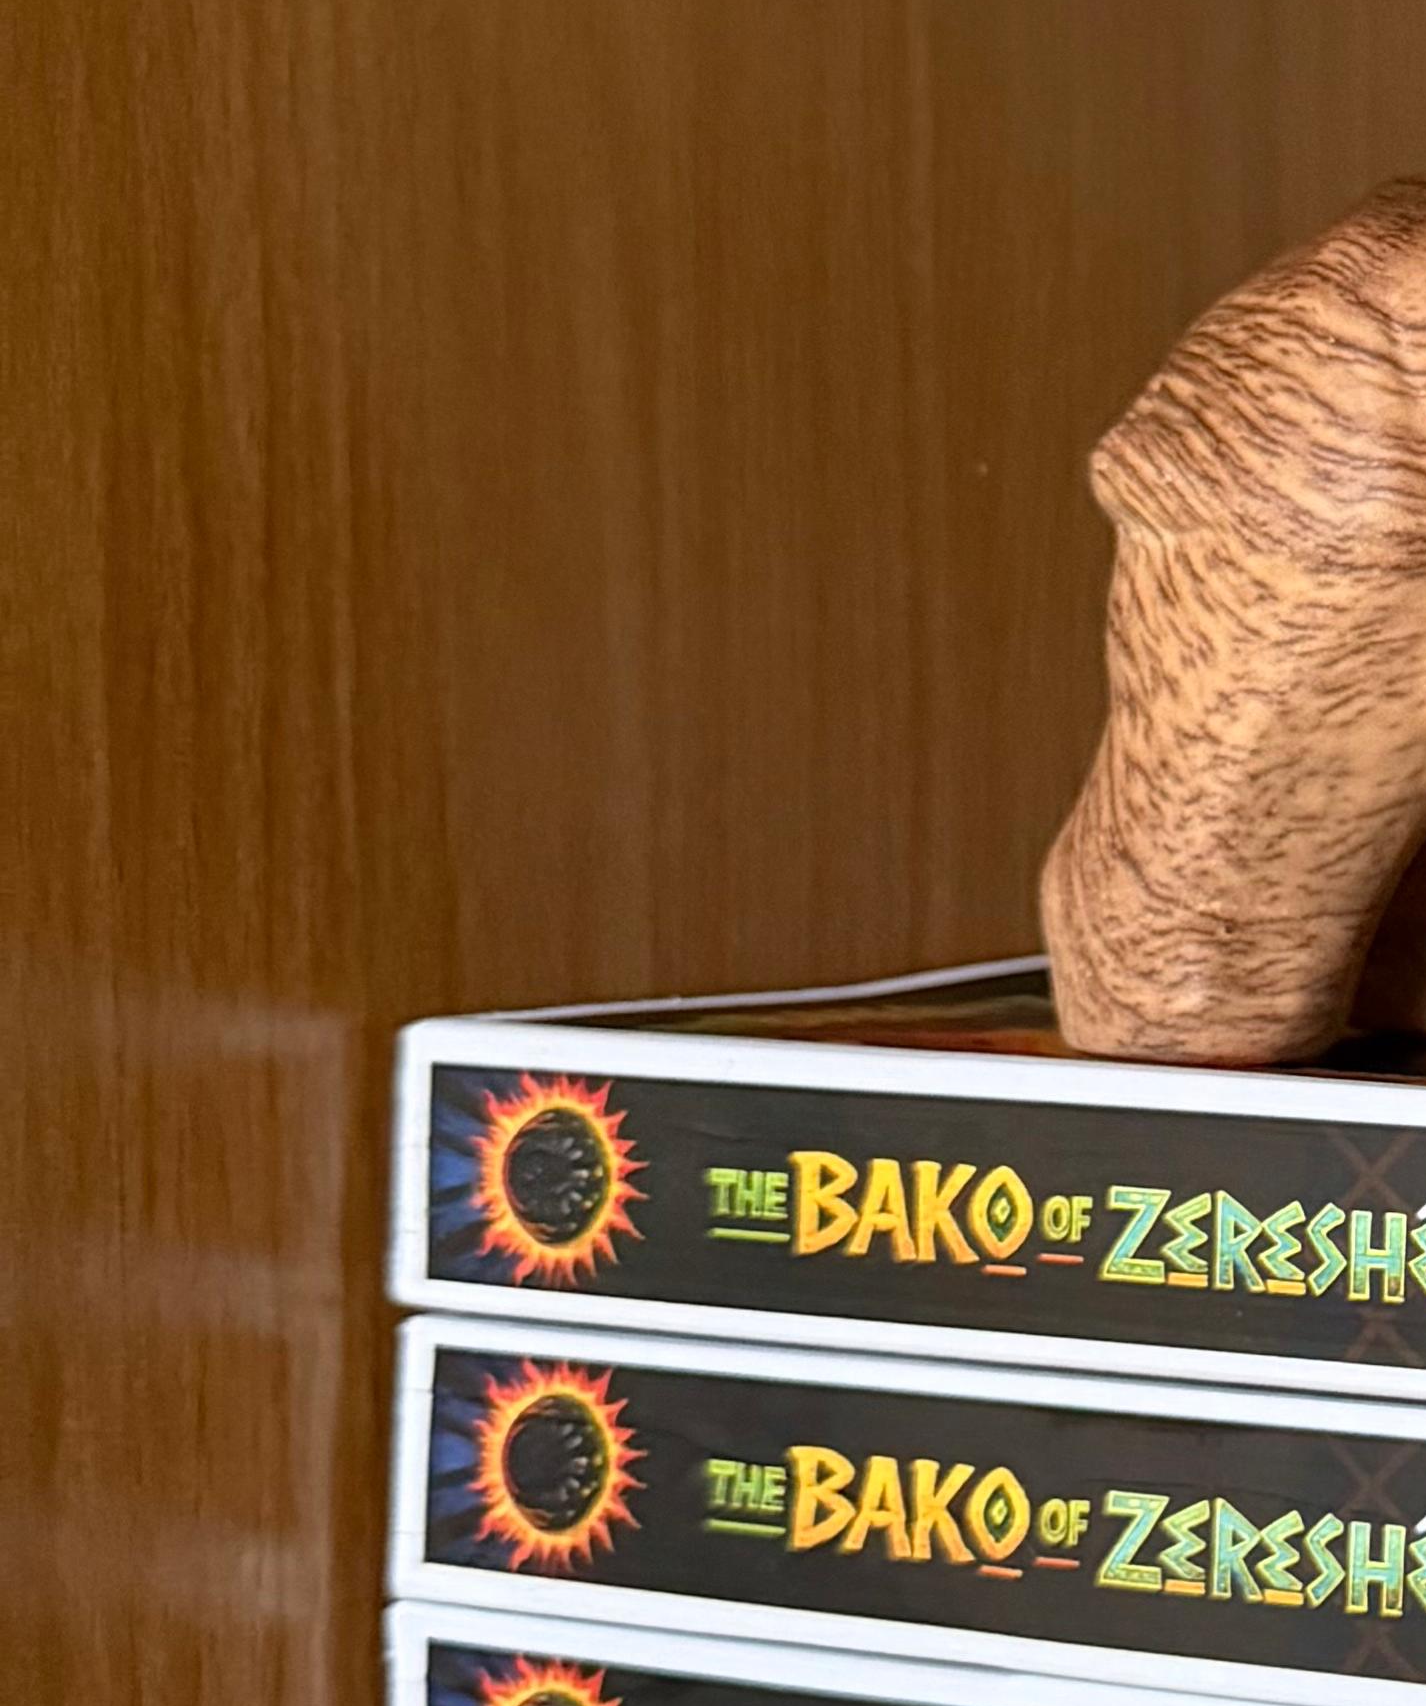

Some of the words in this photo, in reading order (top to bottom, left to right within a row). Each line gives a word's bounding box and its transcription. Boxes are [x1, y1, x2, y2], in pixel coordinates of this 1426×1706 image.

[706, 1168, 788, 1219] THE
[788, 1151, 1033, 1264] BAKO
[1040, 1195, 1093, 1242] OF
[706, 1459, 786, 1512] THE
[786, 1446, 1030, 1564] BAKO
[1037, 1499, 1090, 1547] OF
